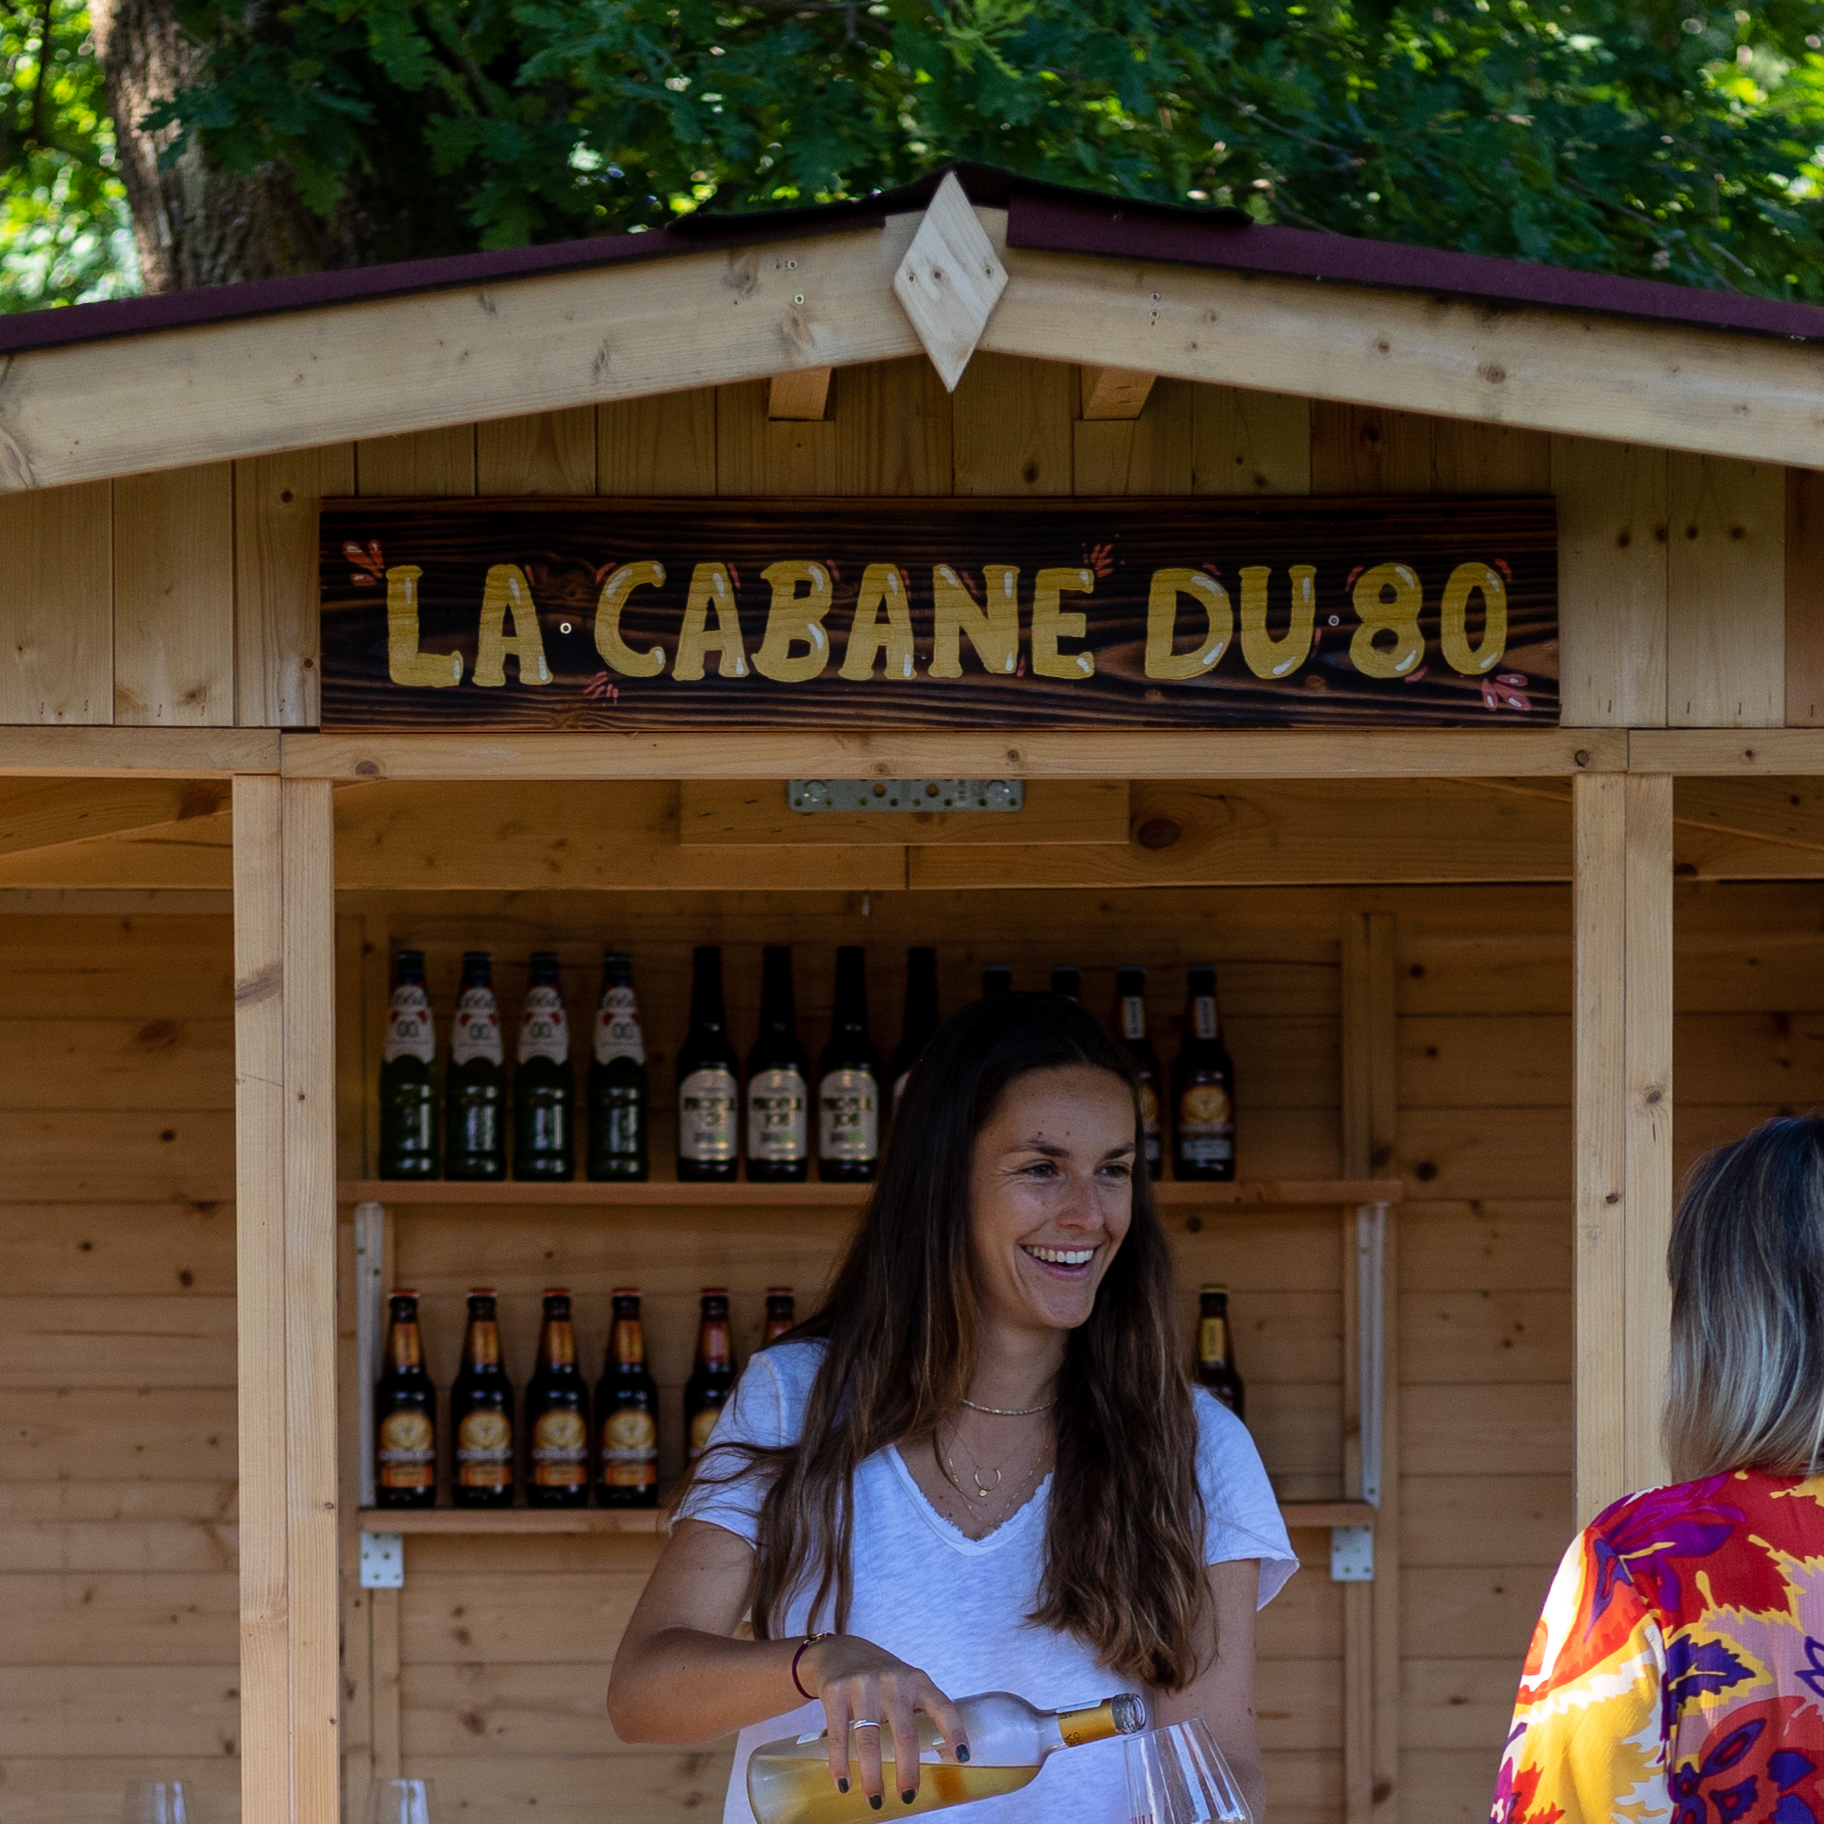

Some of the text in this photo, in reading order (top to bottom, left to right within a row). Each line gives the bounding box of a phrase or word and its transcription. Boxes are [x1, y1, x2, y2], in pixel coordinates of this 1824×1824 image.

[385, 560, 1508, 687] LA CABANE DU 80
